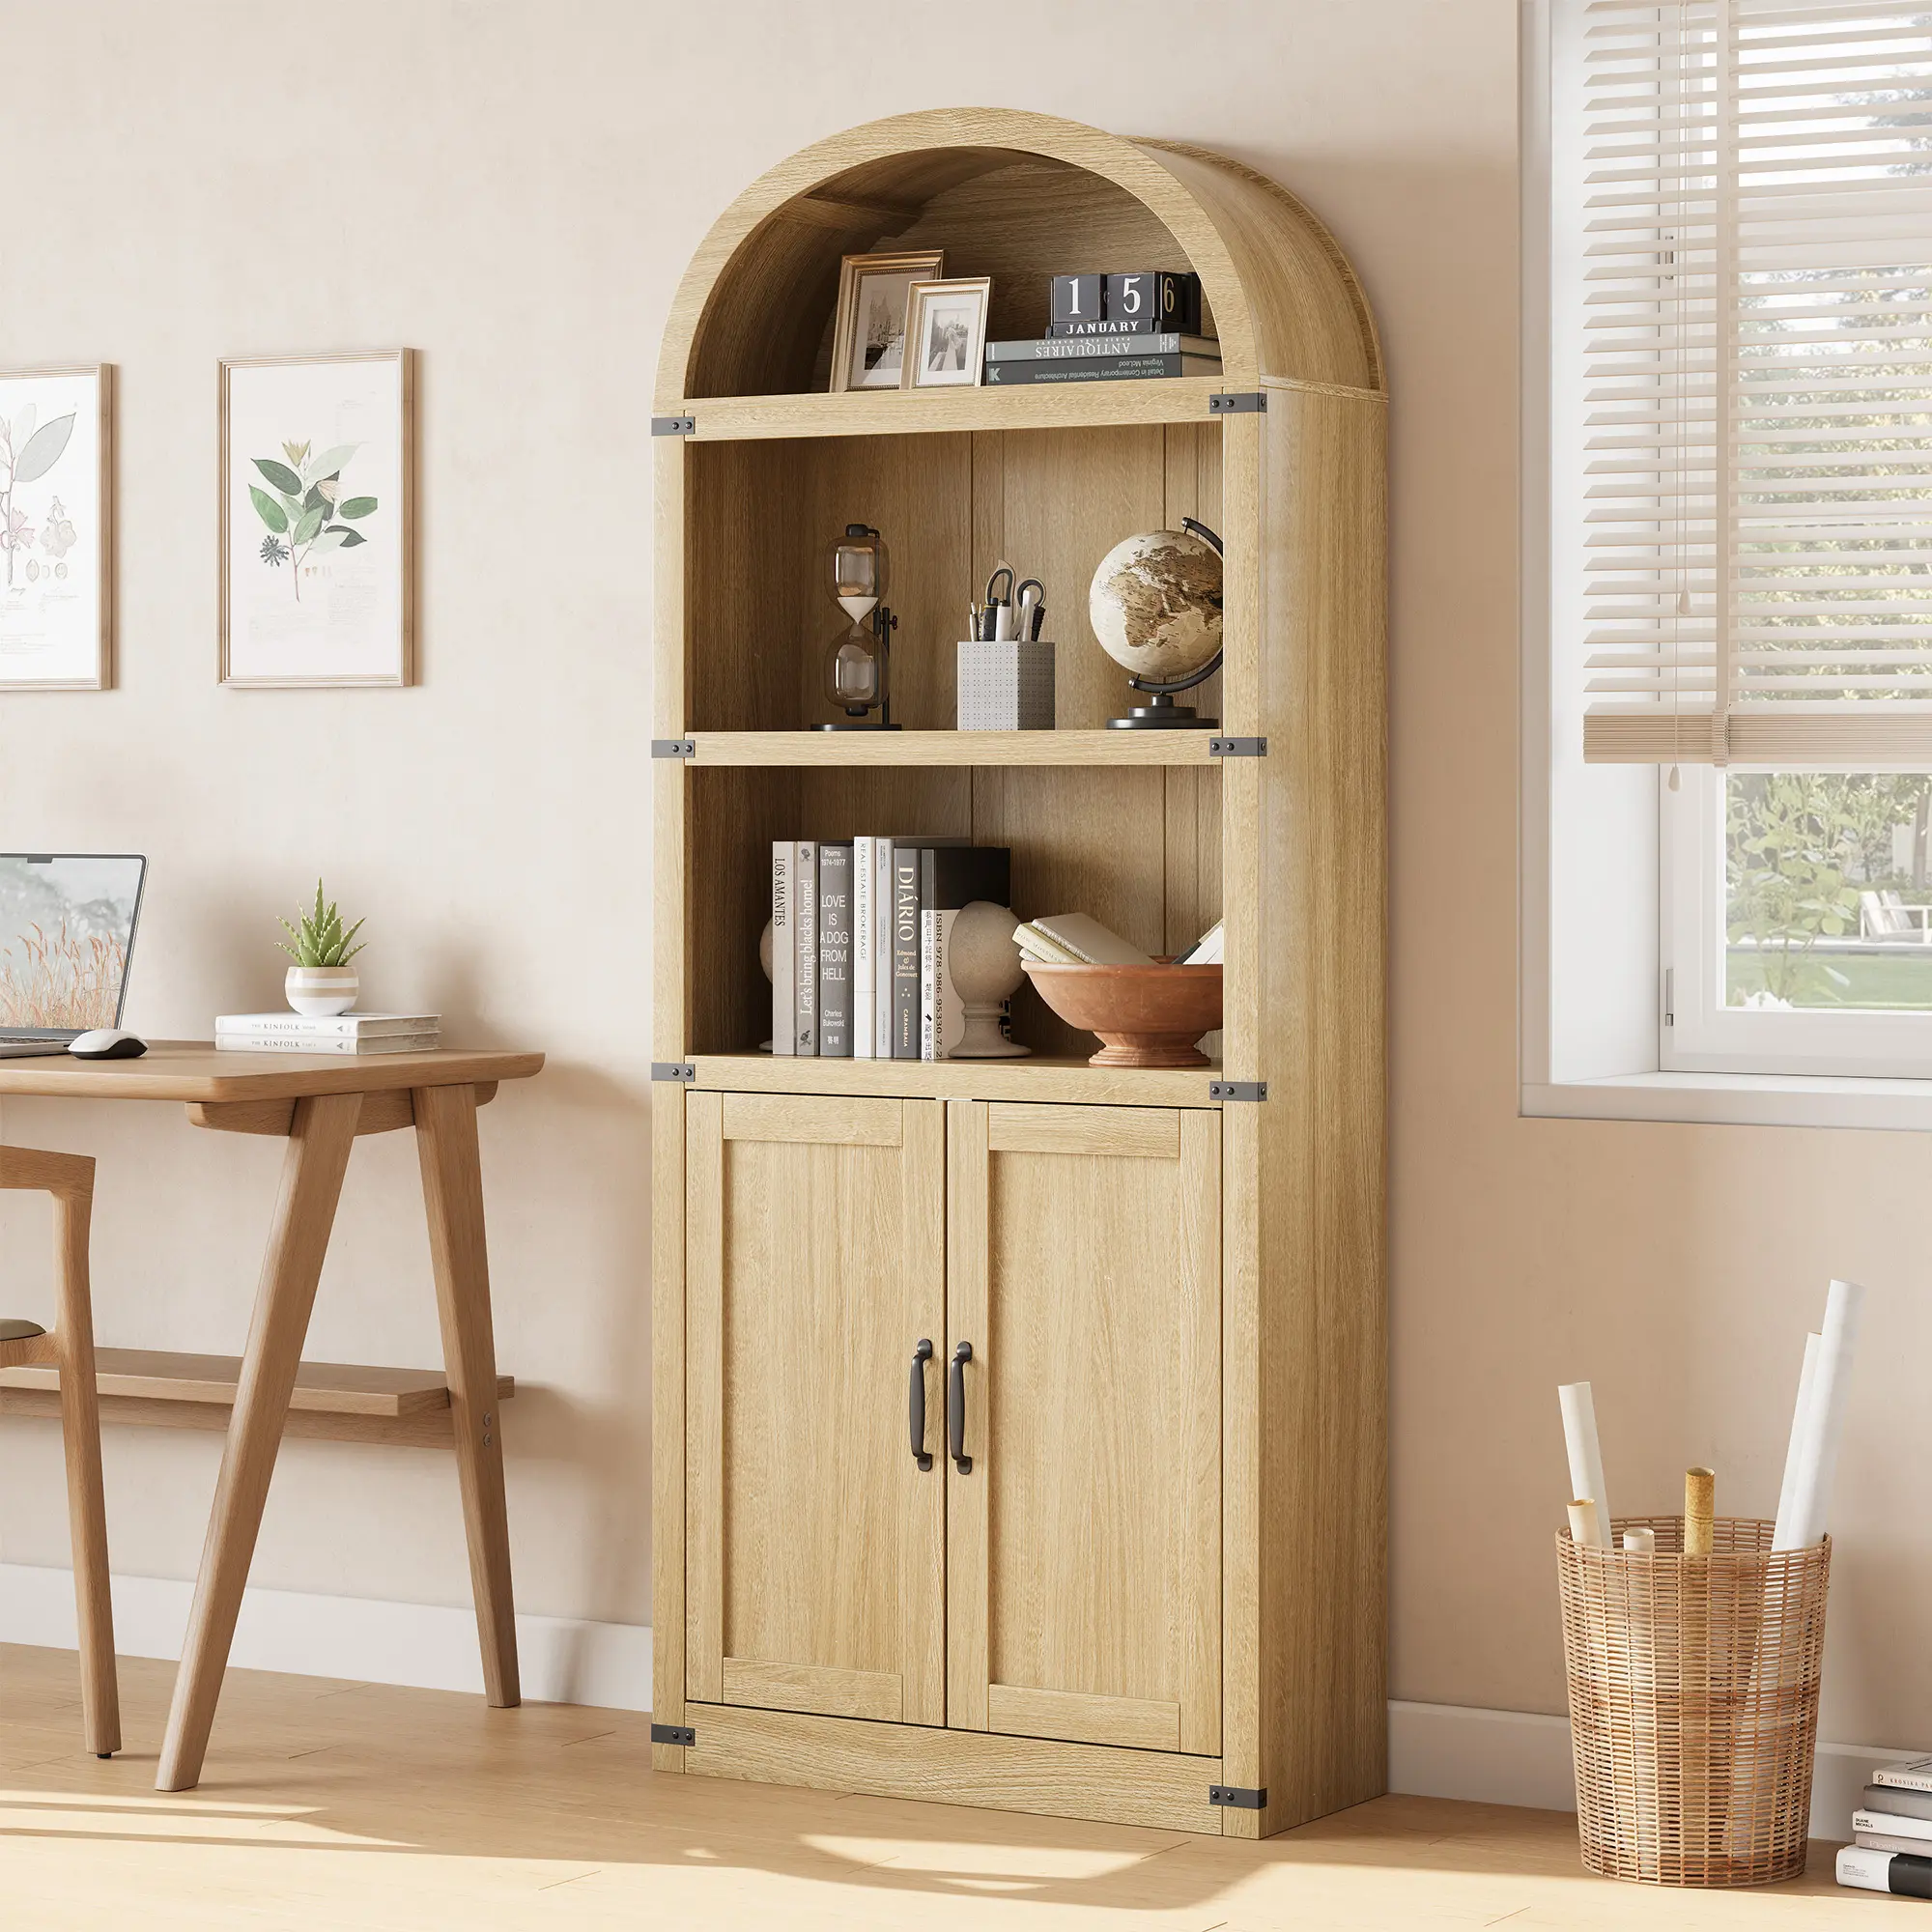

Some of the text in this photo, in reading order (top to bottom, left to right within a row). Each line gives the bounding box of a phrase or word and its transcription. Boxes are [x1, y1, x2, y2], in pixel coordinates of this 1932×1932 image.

[1068, 276, 1141, 315] 1 5
[1163, 276, 1175, 313] 6
[1065, 321, 1139, 334] JANUARY
[1036, 341, 1130, 358] ANTIQUAIRES
[1119, 358, 1164, 368] Virginia McLeod
[1068, 371, 1099, 380] Residential
[1101, 368, 1141, 378] Contemporary
[774, 858, 785, 926] LOS AMANTES
[821, 895, 846, 908] LOVE
[898, 867, 919, 942] DIÁRIO
[828, 913, 838, 926] IS
[800, 879, 817, 1016] Let's bring blacks home!
[821, 950, 847, 962] FROM
[823, 967, 845, 980] HELL
